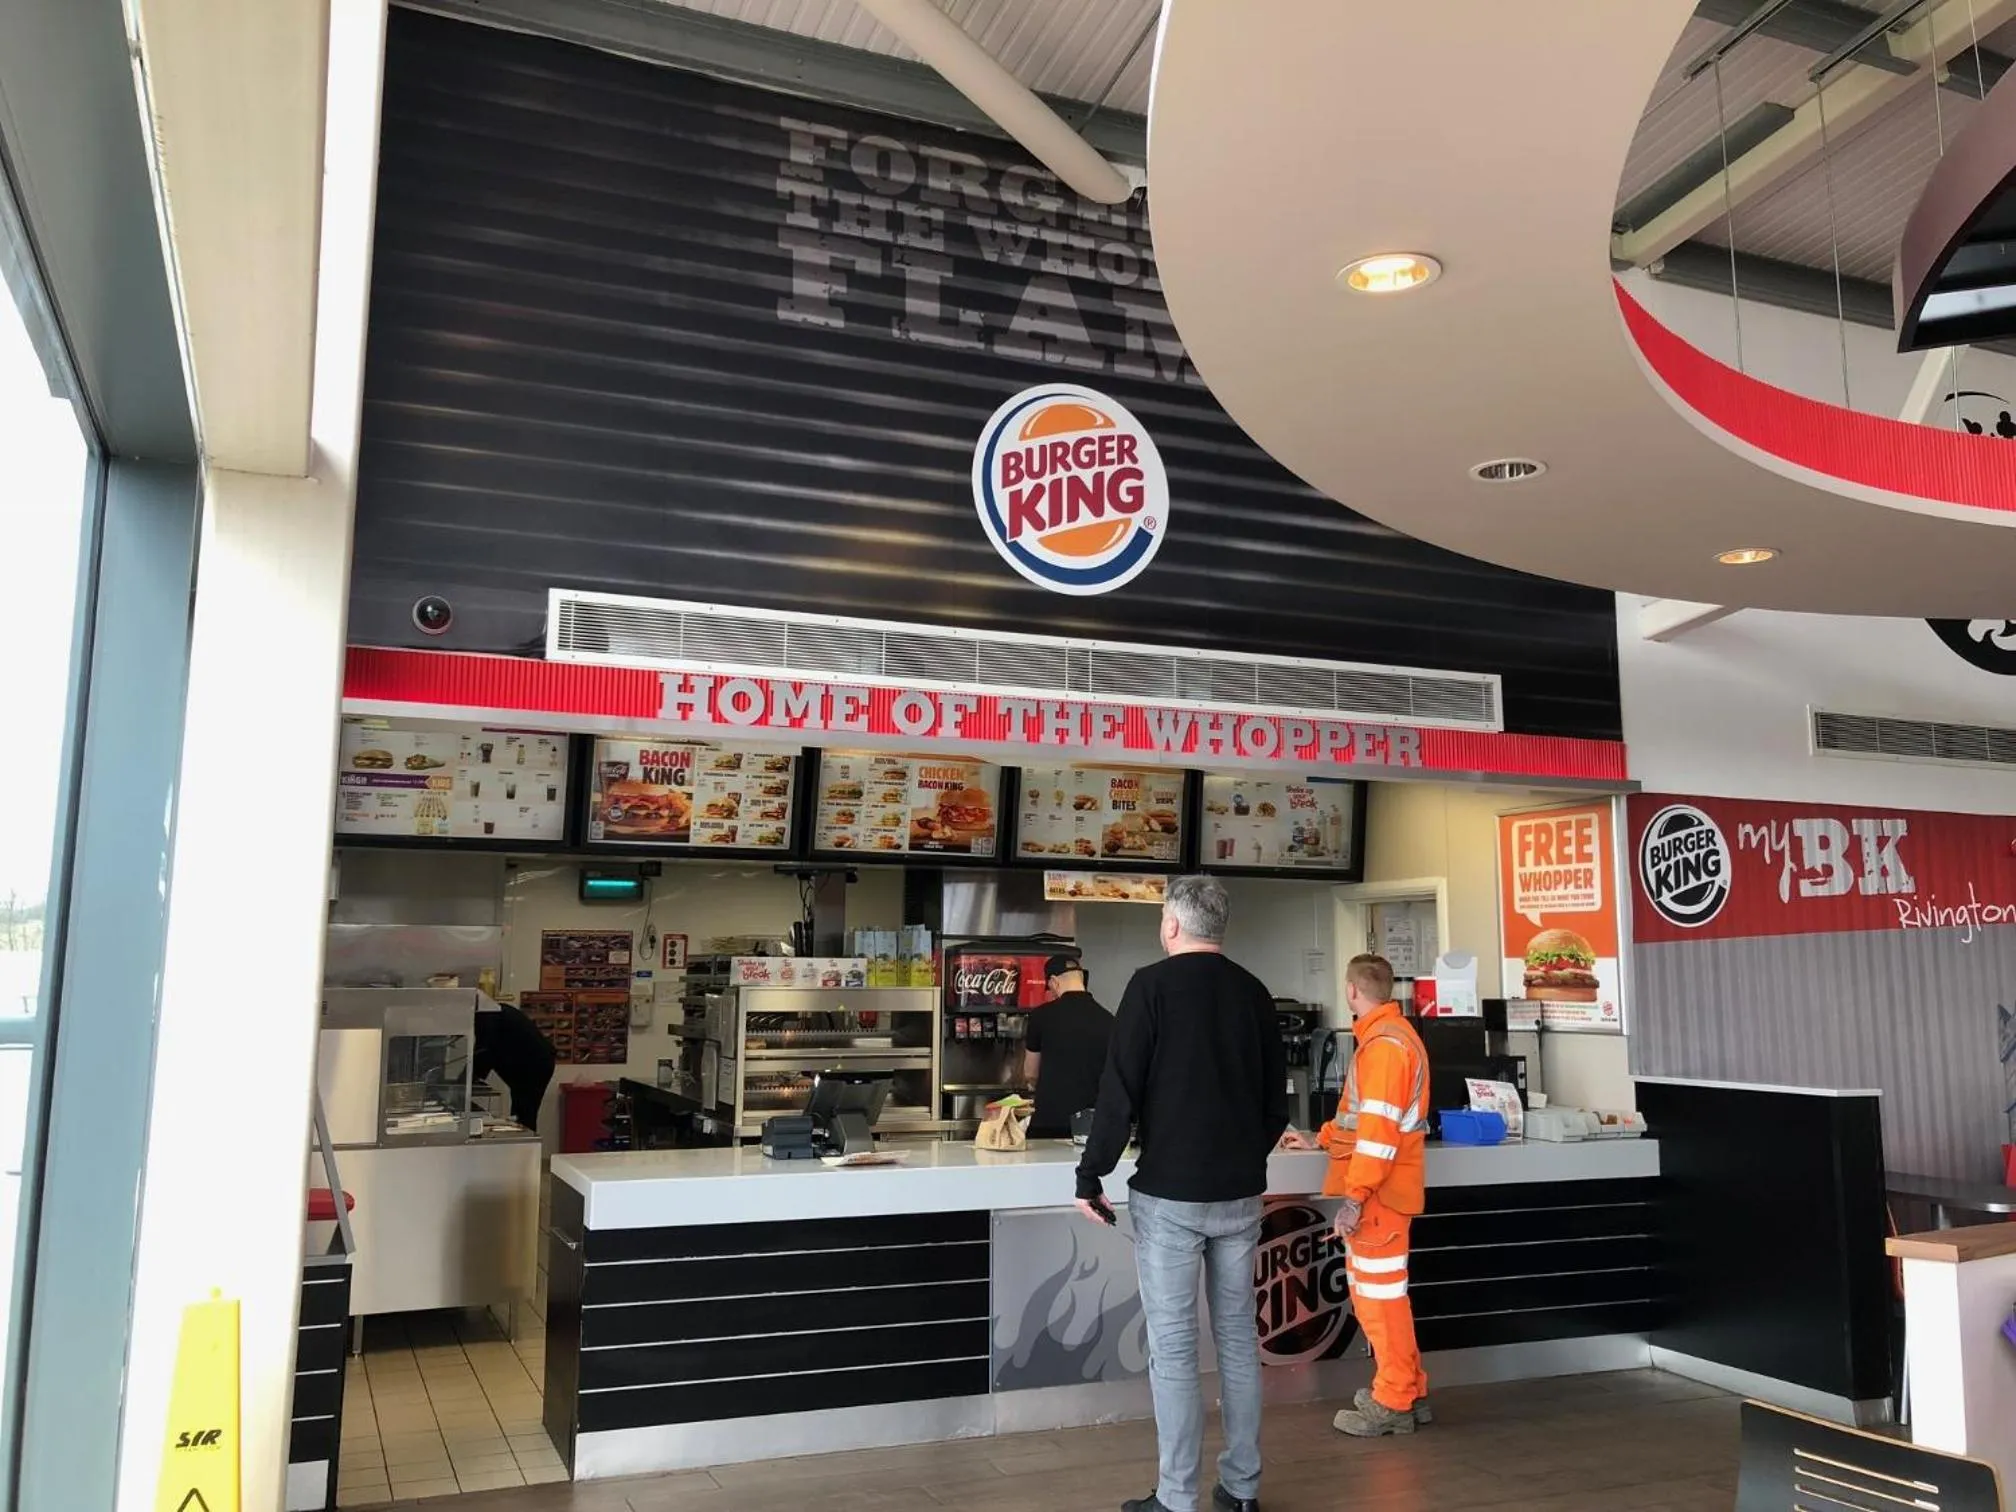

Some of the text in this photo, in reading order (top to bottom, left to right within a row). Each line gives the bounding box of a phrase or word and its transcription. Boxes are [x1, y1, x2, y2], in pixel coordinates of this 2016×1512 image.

[776, 176, 1162, 291] THE WHO
[1001, 434, 1138, 489] BURGER
[1008, 467, 1145, 540] KING
[658, 672, 1422, 767] HOME OF THE WHOPPER
[639, 748, 691, 769] BACON
[918, 766, 966, 780] CHICKEN
[642, 767, 685, 787] KING
[918, 779, 965, 791] BACON KING
[1110, 778, 1140, 789] BACON
[1112, 800, 1137, 811] BITES
[1518, 818, 1594, 867] FREE
[1651, 829, 1717, 869] BURGER
[1654, 848, 1721, 899] KING
[1738, 818, 1916, 904] my BK
[1519, 868, 1594, 892] WHOPPER
[1893, 882, 2016, 943] Rivington
[954, 968, 1018, 995] Coca-Cola
[175, 1429, 222, 1448] SIR
